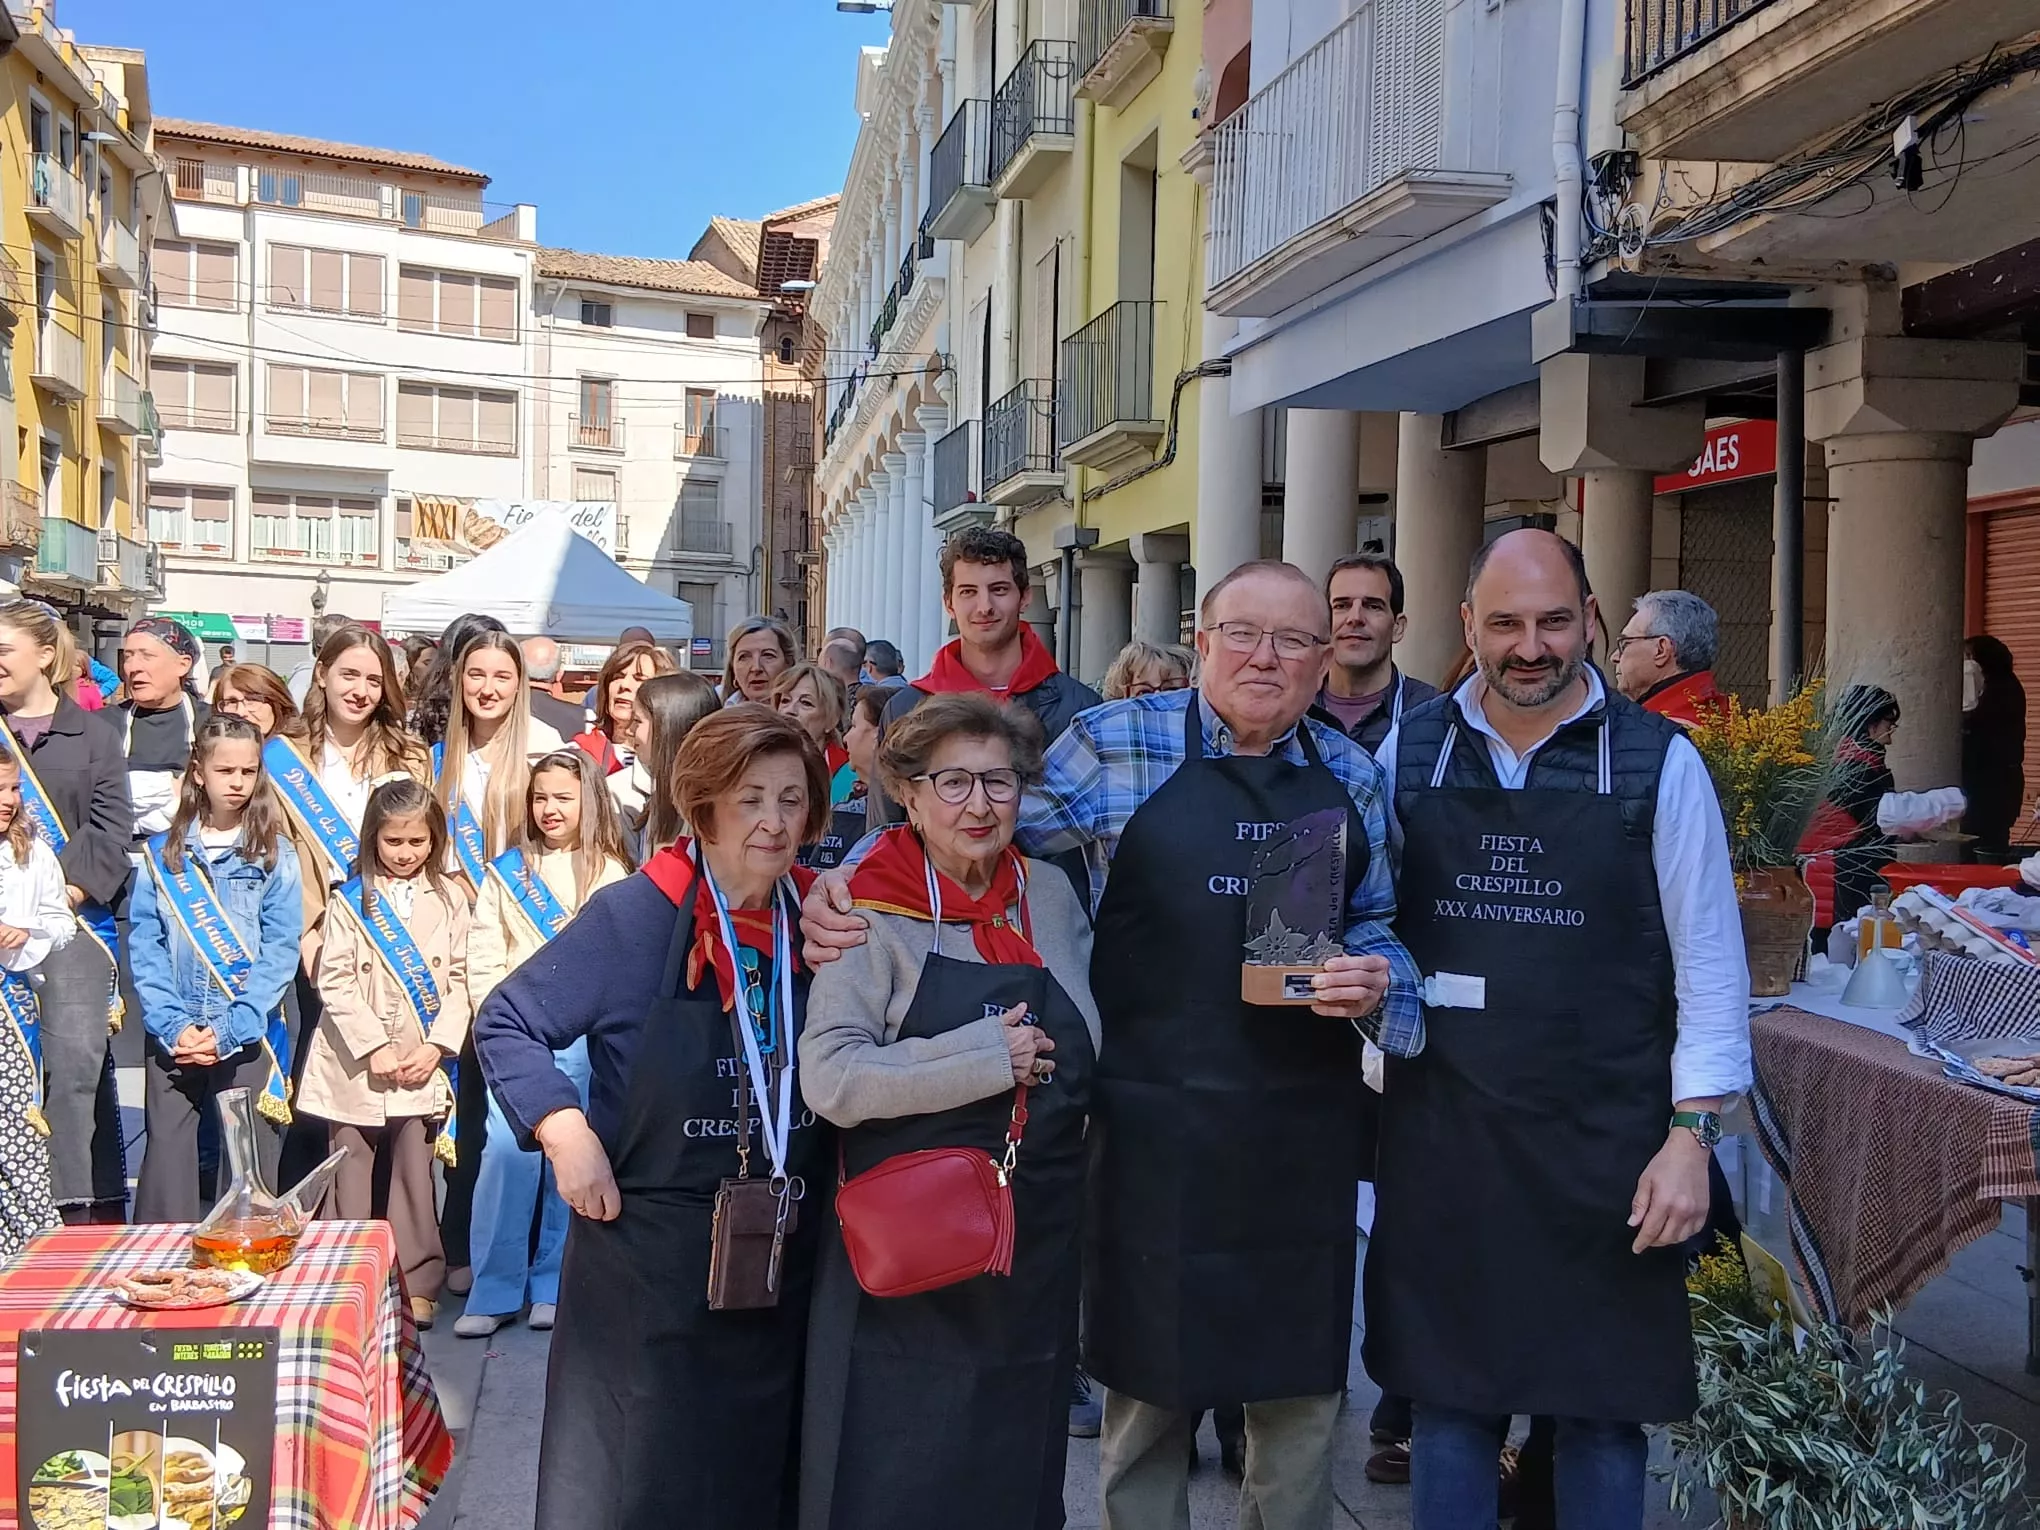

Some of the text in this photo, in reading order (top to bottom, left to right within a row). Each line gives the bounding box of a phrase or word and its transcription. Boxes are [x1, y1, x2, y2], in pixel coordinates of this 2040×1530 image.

[415, 503, 457, 540] XXXI
[504, 505, 602, 528] Fie del
[283, 768, 337, 835] Dama de
[820, 836, 843, 849] STA
[1479, 834, 1544, 853] FIESTA
[1490, 856, 1528, 873] DEL
[1456, 874, 1562, 896] CRESPILLO
[1434, 900, 1585, 926] XXX ANIVERSARIO
[189, 898, 248, 966] Infantil
[395, 944, 440, 1016] Infantil
[8, 979, 39, 1025] 2025
[683, 1109, 816, 1138] CRESPLO
[133, 1376, 150, 1391] DEL
